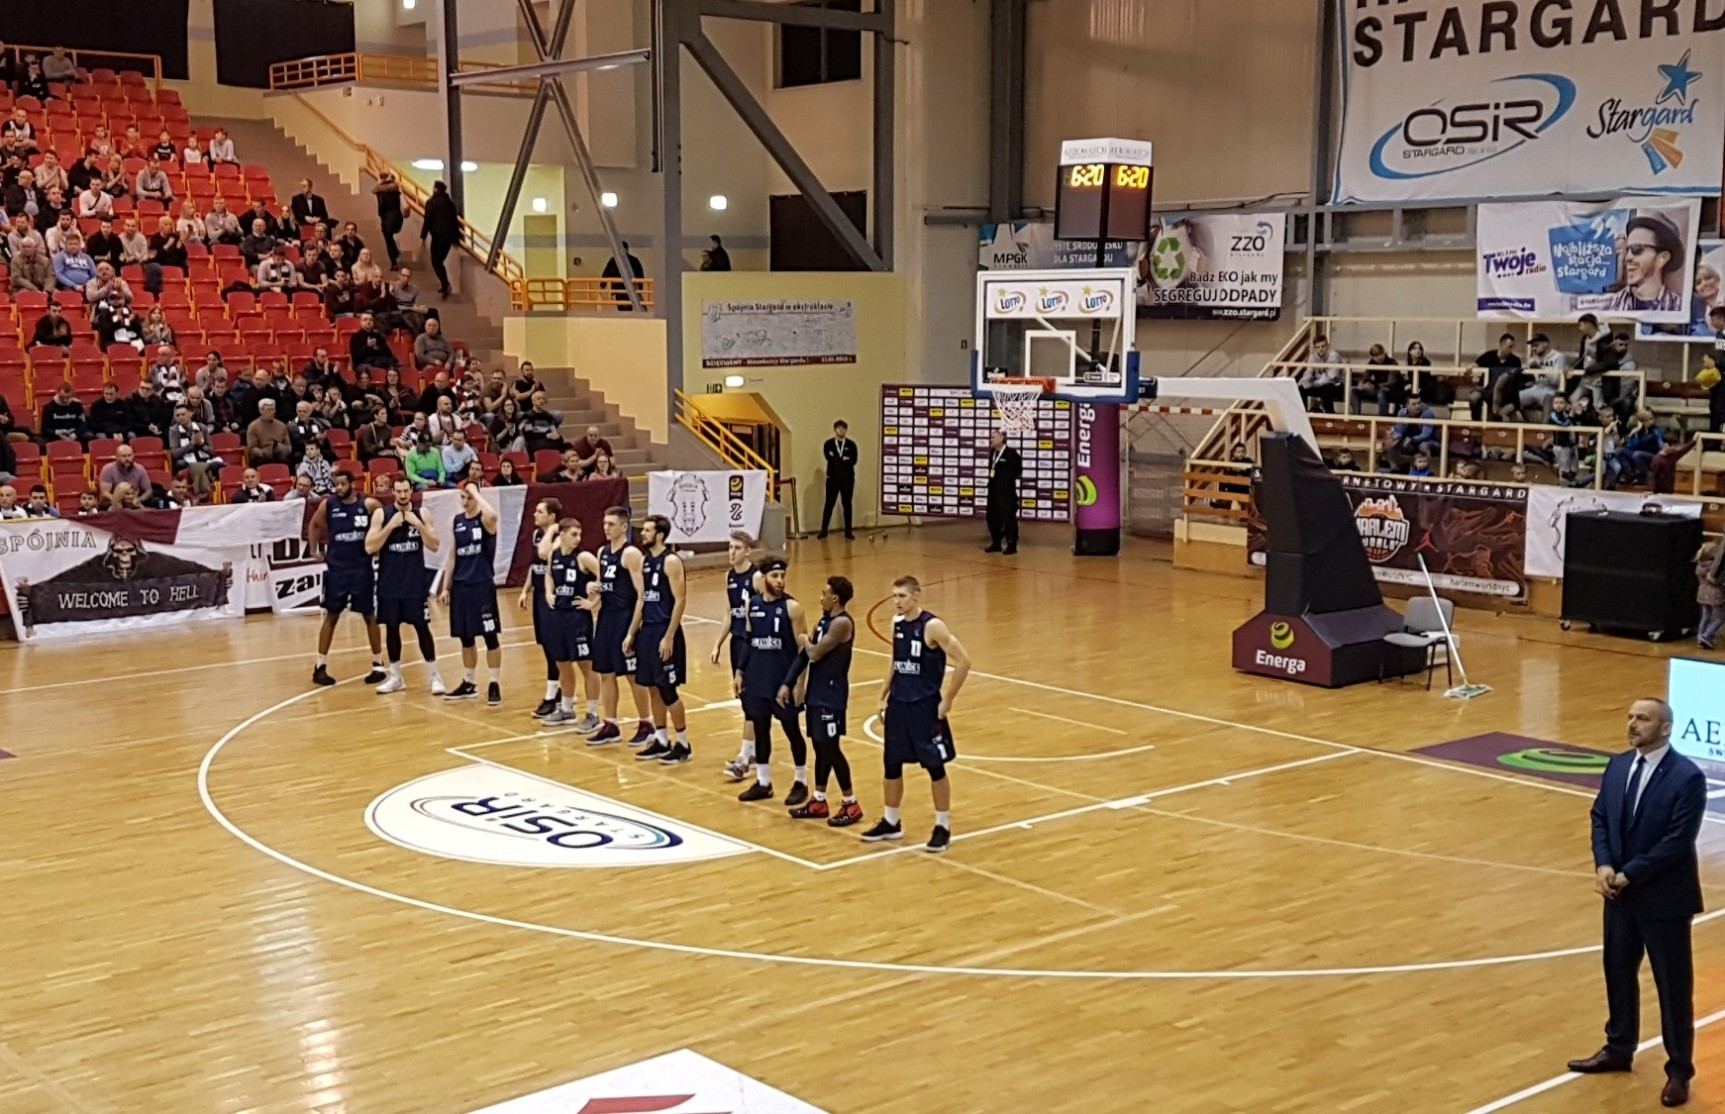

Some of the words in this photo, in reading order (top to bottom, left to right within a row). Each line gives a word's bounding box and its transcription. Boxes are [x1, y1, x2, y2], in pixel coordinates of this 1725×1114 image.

[1586, 98, 1699, 143] Stargard
[1071, 164, 1105, 188] 6:20
[1117, 166, 1150, 189] 6:20
[1231, 236, 1265, 251] ZZO
[994, 253, 1028, 264] MPGK
[1483, 247, 1536, 275] Twoje
[1525, 263, 1547, 274] radio
[1218, 271, 1239, 282] EKO
[1240, 271, 1257, 285] jak
[1261, 273, 1278, 285] my
[1000, 296, 1021, 310] LOTTO
[1041, 296, 1063, 309] LOTTO
[1085, 294, 1107, 309] LOTTO
[1155, 288, 1218, 302] SEGREGUJ
[1219, 289, 1277, 303] ODPADY
[1436, 484, 1527, 499] STARGARD
[0, 528, 97, 555] SPÓJNIA
[58, 591, 128, 608] WELCOME
[140, 589, 160, 604] TO
[169, 585, 199, 601] HELL
[483, 619, 496, 632] 18
[774, 617, 780, 632] 1
[577, 643, 590, 657] 13
[626, 658, 638, 671] 12
[1255, 649, 1306, 675] Energa
[826, 722, 837, 738] 0
[1680, 717, 1725, 746] AE
